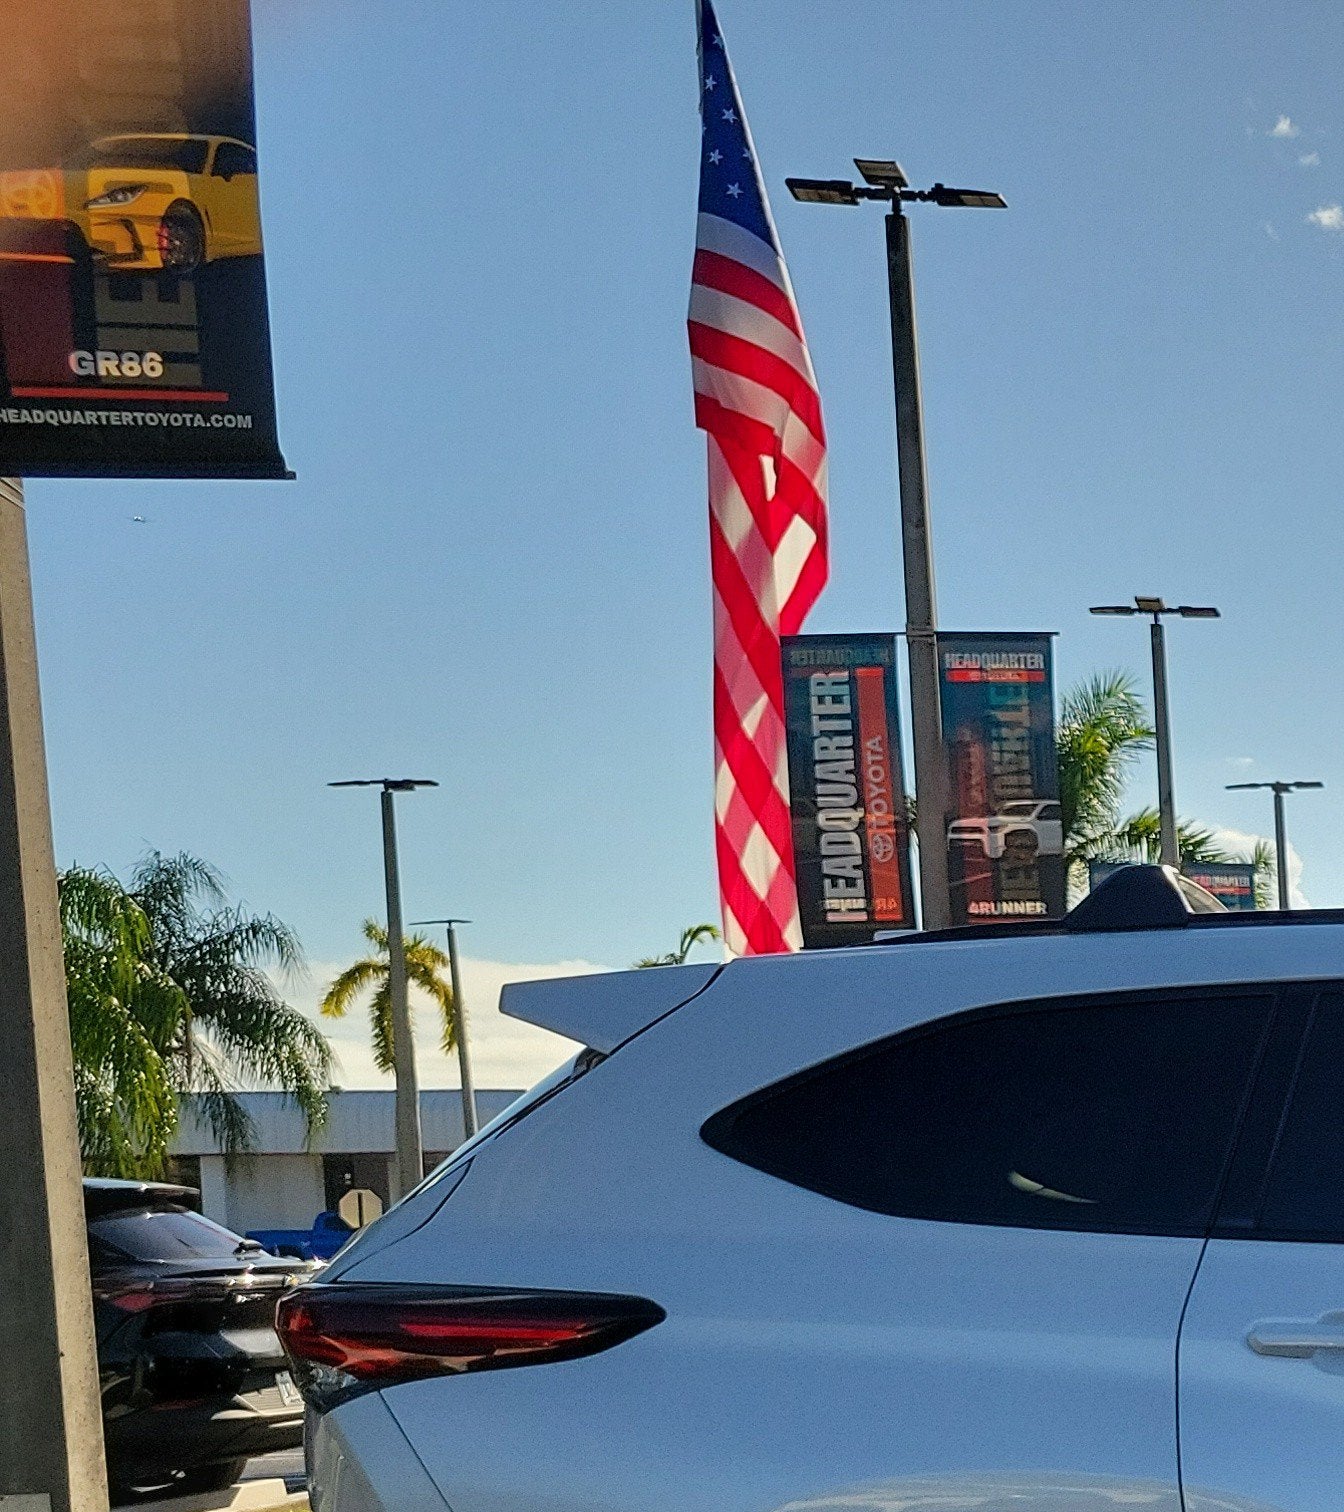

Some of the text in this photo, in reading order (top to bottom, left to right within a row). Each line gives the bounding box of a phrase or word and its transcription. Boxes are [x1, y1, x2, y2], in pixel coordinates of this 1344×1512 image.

[68, 351, 164, 378] GR86
[945, 652, 1045, 670] HEADQUARTER
[865, 735, 892, 828] TOYOTA
[811, 669, 869, 922] HEADQUARTER
[968, 901, 1049, 916] 4RUNNER
